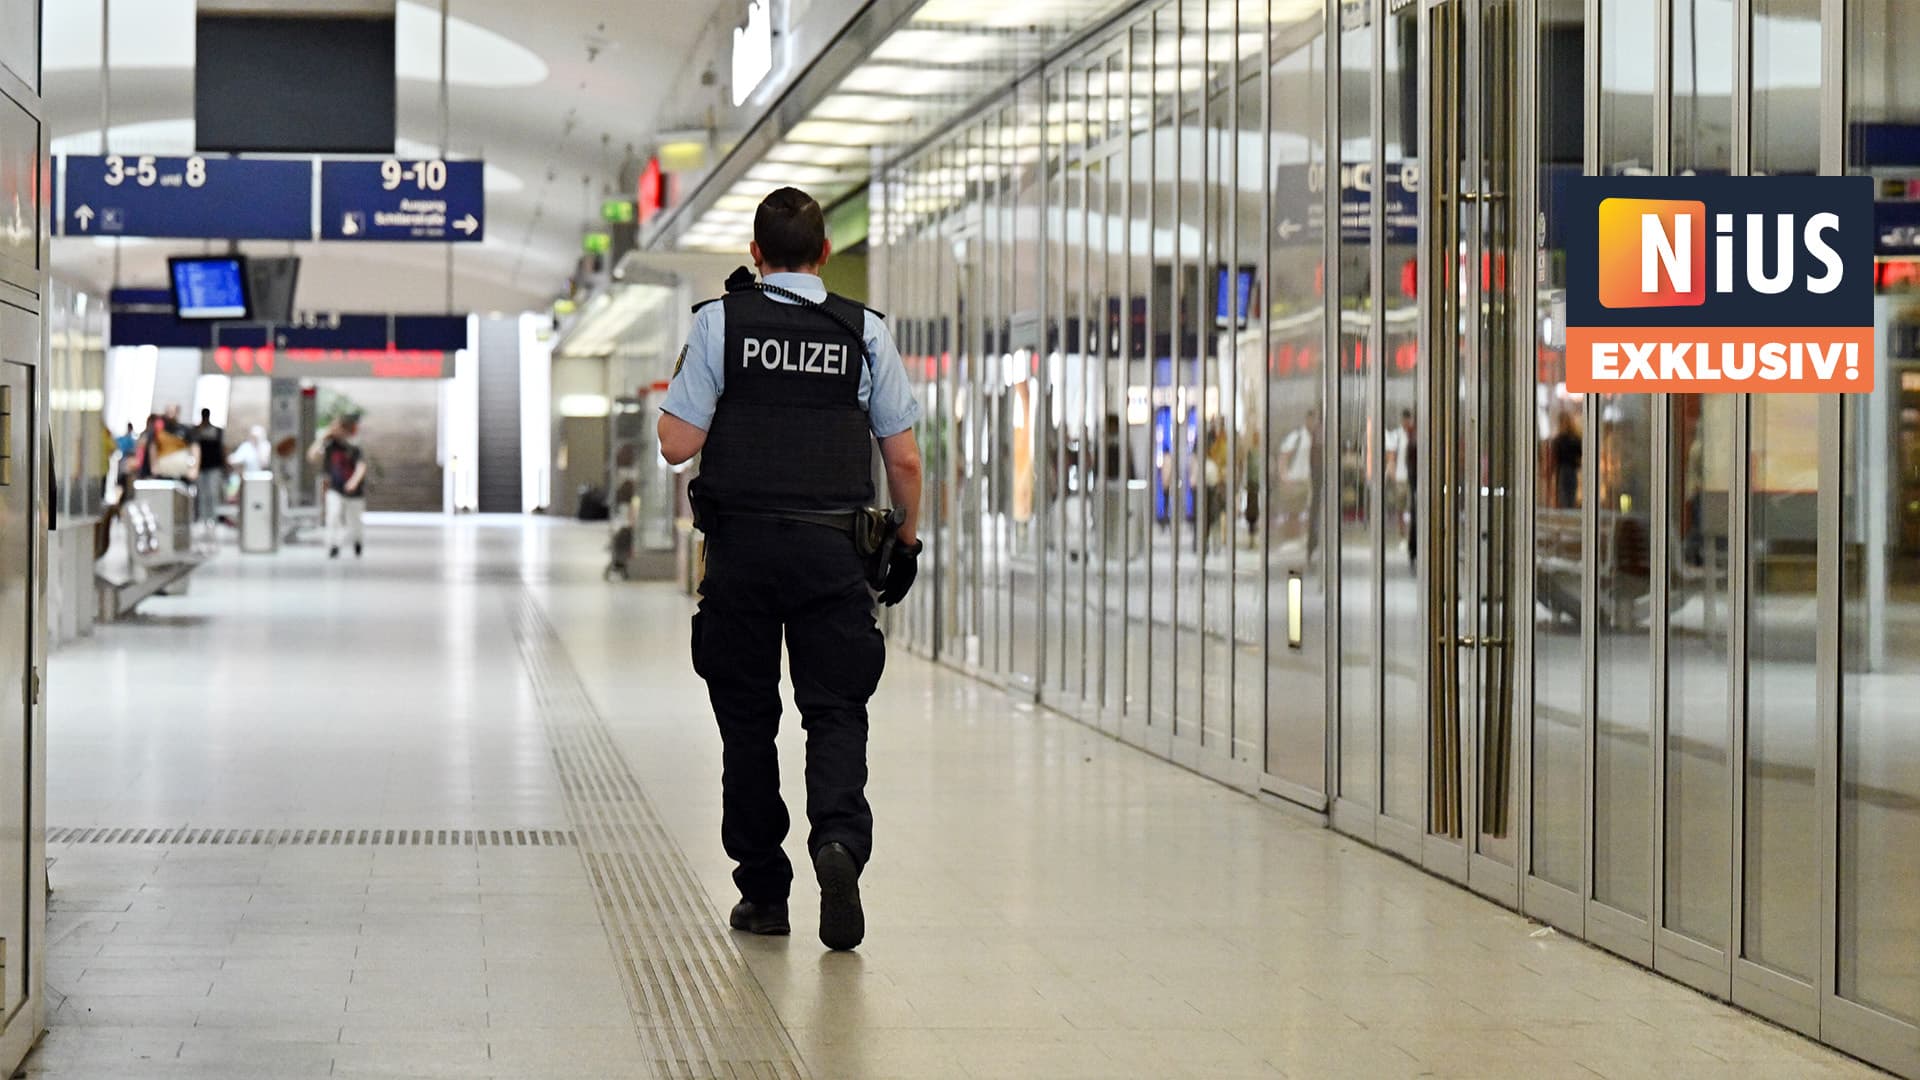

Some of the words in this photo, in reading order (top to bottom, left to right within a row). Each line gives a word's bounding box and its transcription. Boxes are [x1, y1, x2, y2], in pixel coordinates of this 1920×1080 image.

[104, 155, 157, 188] 3-5
[186, 156, 206, 188] 8
[381, 160, 447, 190] 9-10
[743, 337, 848, 375] POLIZEI
